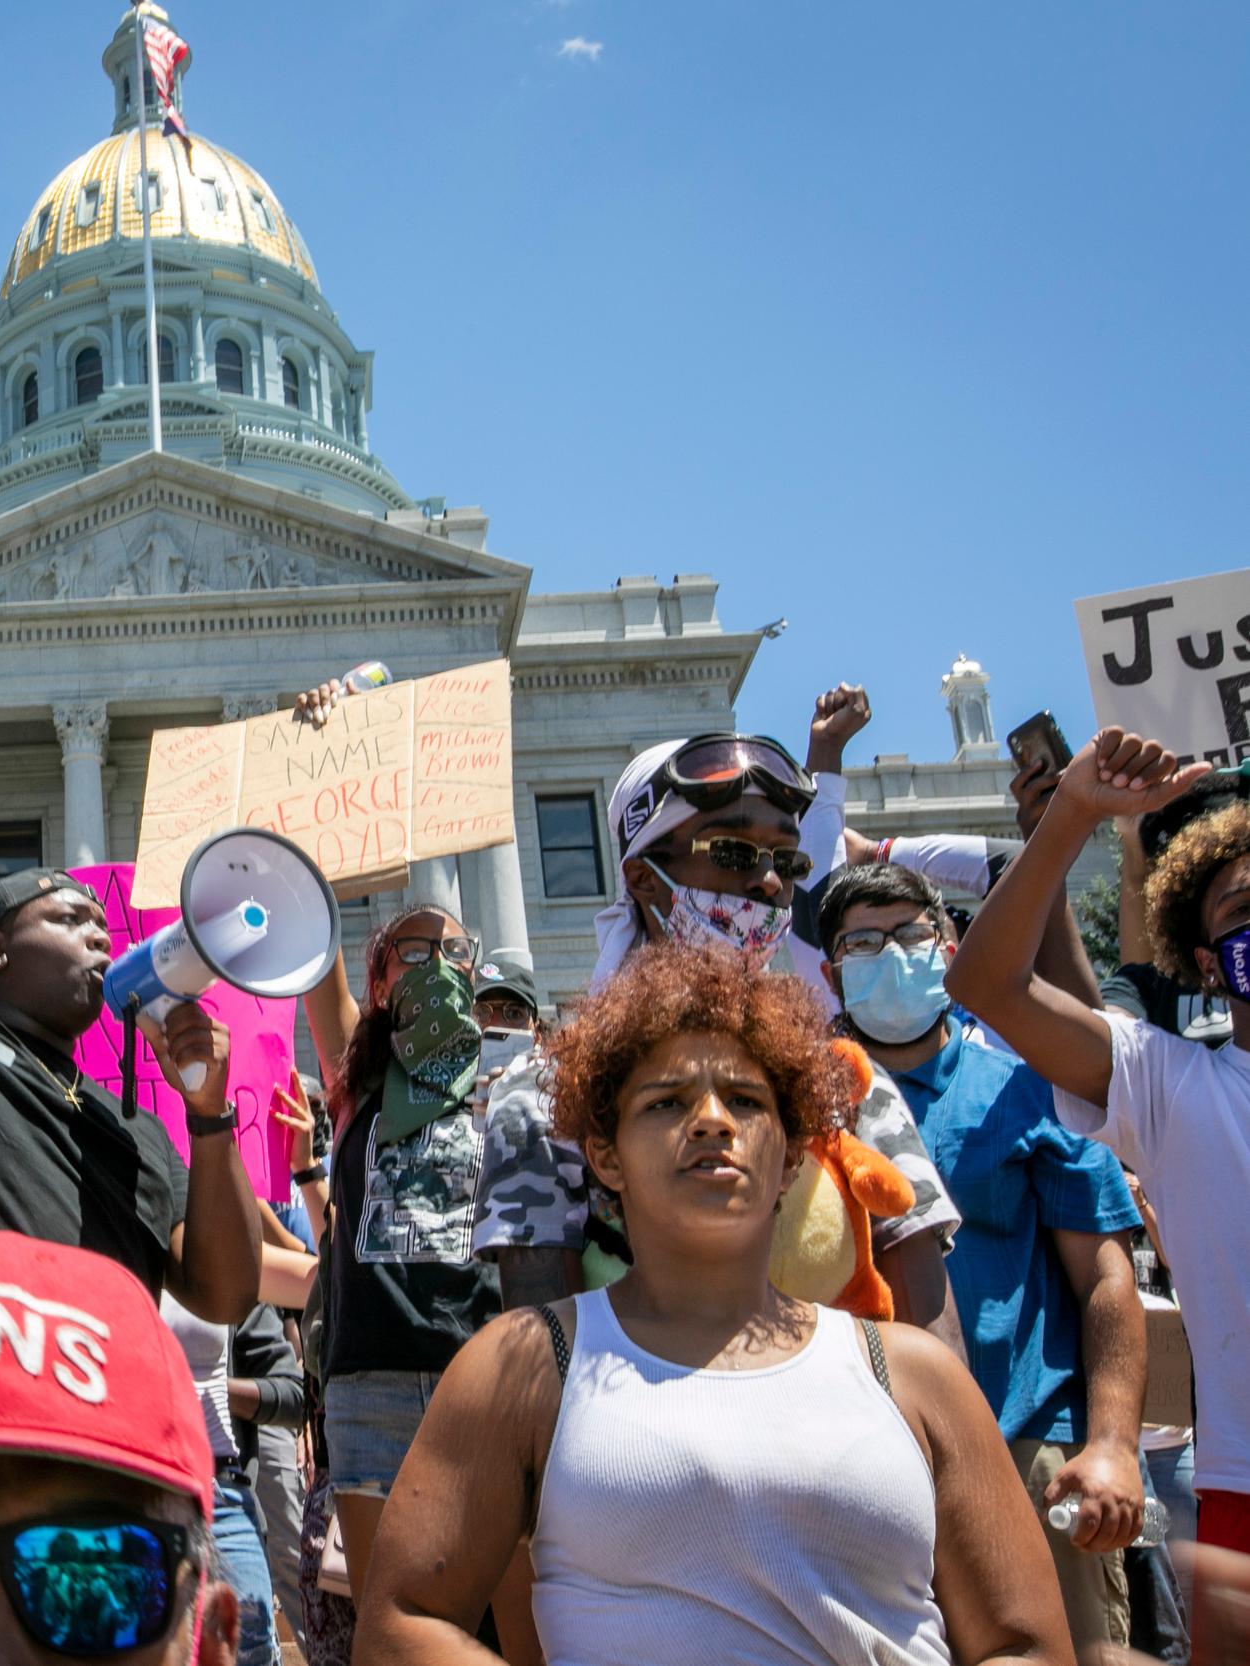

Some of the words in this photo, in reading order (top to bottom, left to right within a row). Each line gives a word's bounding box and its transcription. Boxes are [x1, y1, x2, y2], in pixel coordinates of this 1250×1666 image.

[417, 697, 488, 719] Rice
[421, 728, 504, 752] Michael
[287, 731, 398, 786] NAME
[426, 752, 500, 777] Brown
[246, 768, 412, 833] GEORGE
[424, 815, 507, 838] Garner
[317, 817, 407, 875] OYD
